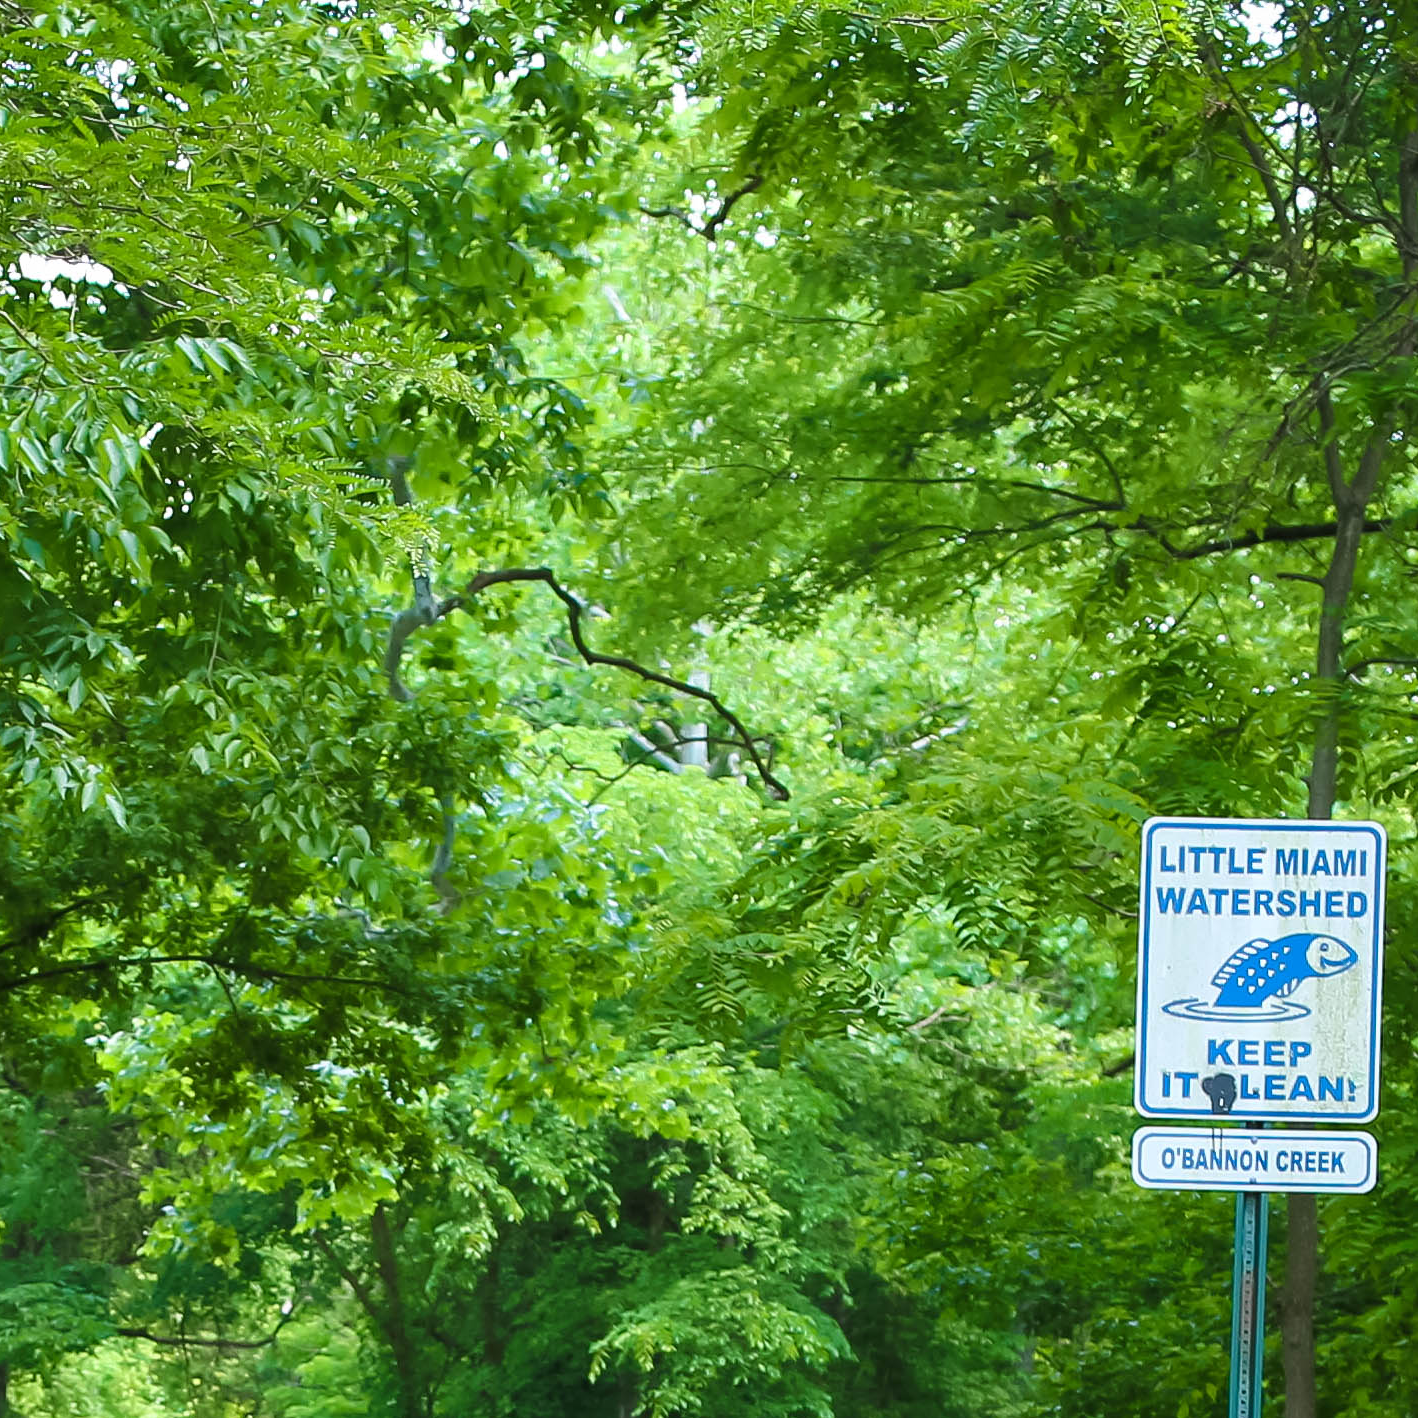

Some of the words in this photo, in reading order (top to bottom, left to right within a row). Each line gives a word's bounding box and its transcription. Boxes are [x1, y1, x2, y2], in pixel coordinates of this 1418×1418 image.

[1160, 845, 1264, 874] LITTLE
[1275, 848, 1367, 876] MIAMI
[1156, 887, 1368, 918] WATERSHED
[1207, 1039, 1312, 1067] KEEP
[1162, 1072, 1198, 1098] IT
[1204, 1073, 1356, 1102] LEAN!
[1161, 1148, 1270, 1173] O'BANNON
[1275, 1150, 1345, 1174] CREEK
